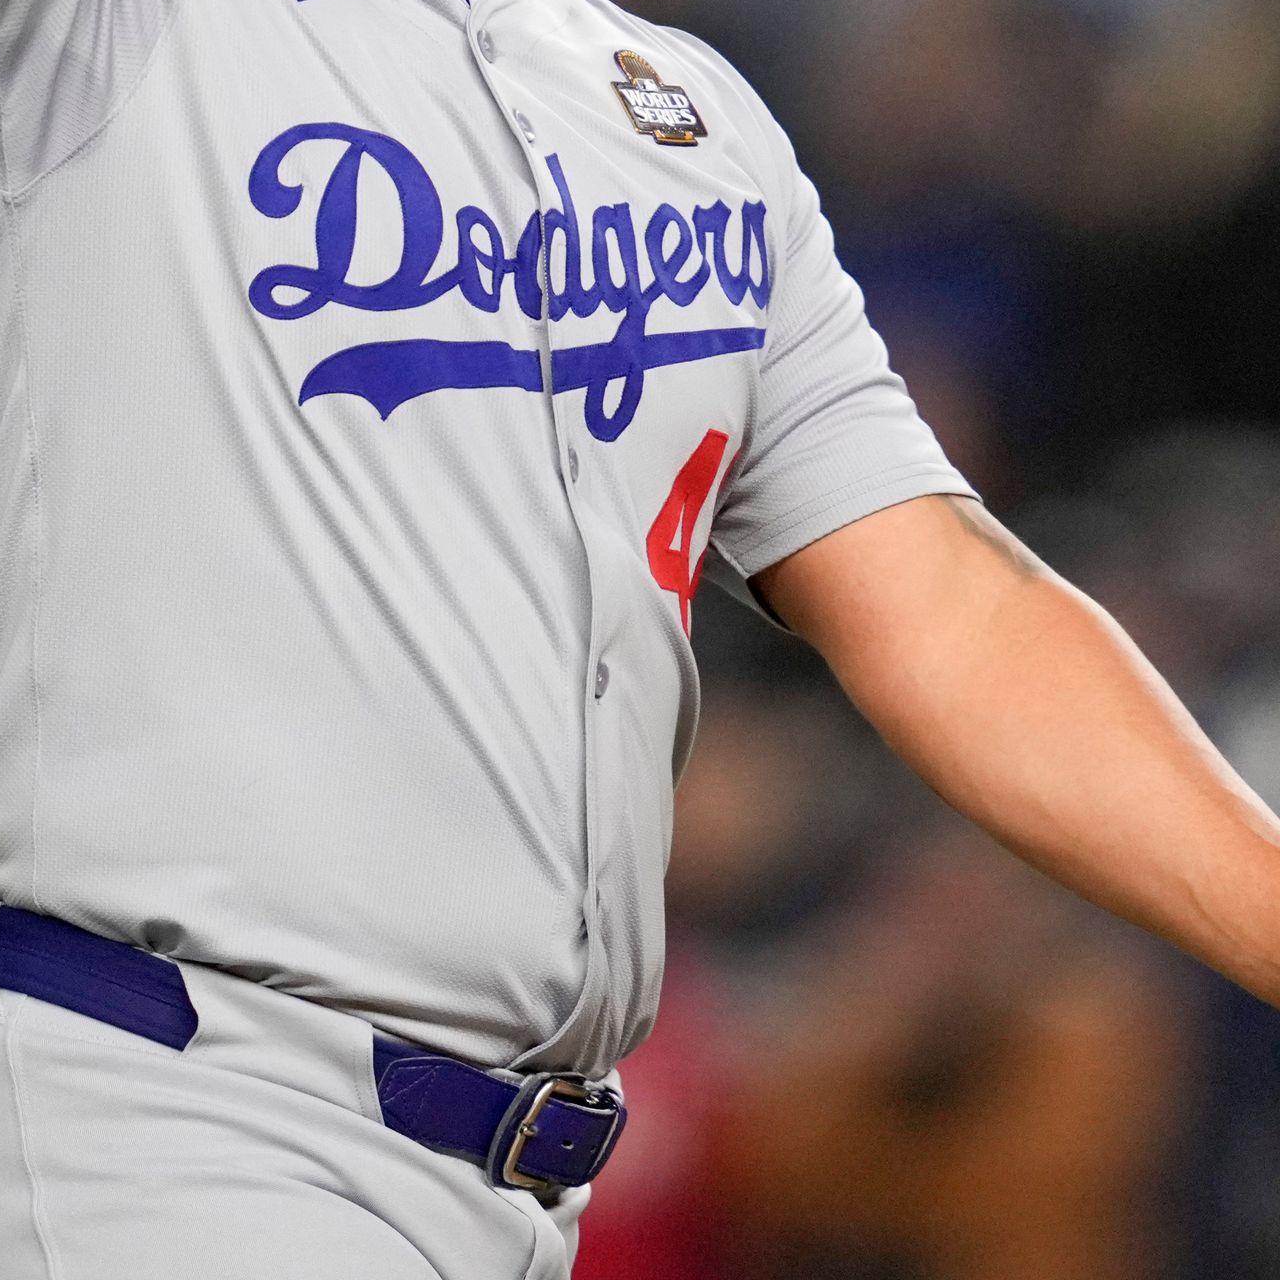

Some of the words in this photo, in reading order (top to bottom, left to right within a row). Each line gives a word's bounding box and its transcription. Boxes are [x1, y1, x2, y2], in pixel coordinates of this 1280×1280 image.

[619, 88, 689, 109] WORLD
[633, 105, 697, 127] SERIES
[249, 124, 768, 443] Dodgers
